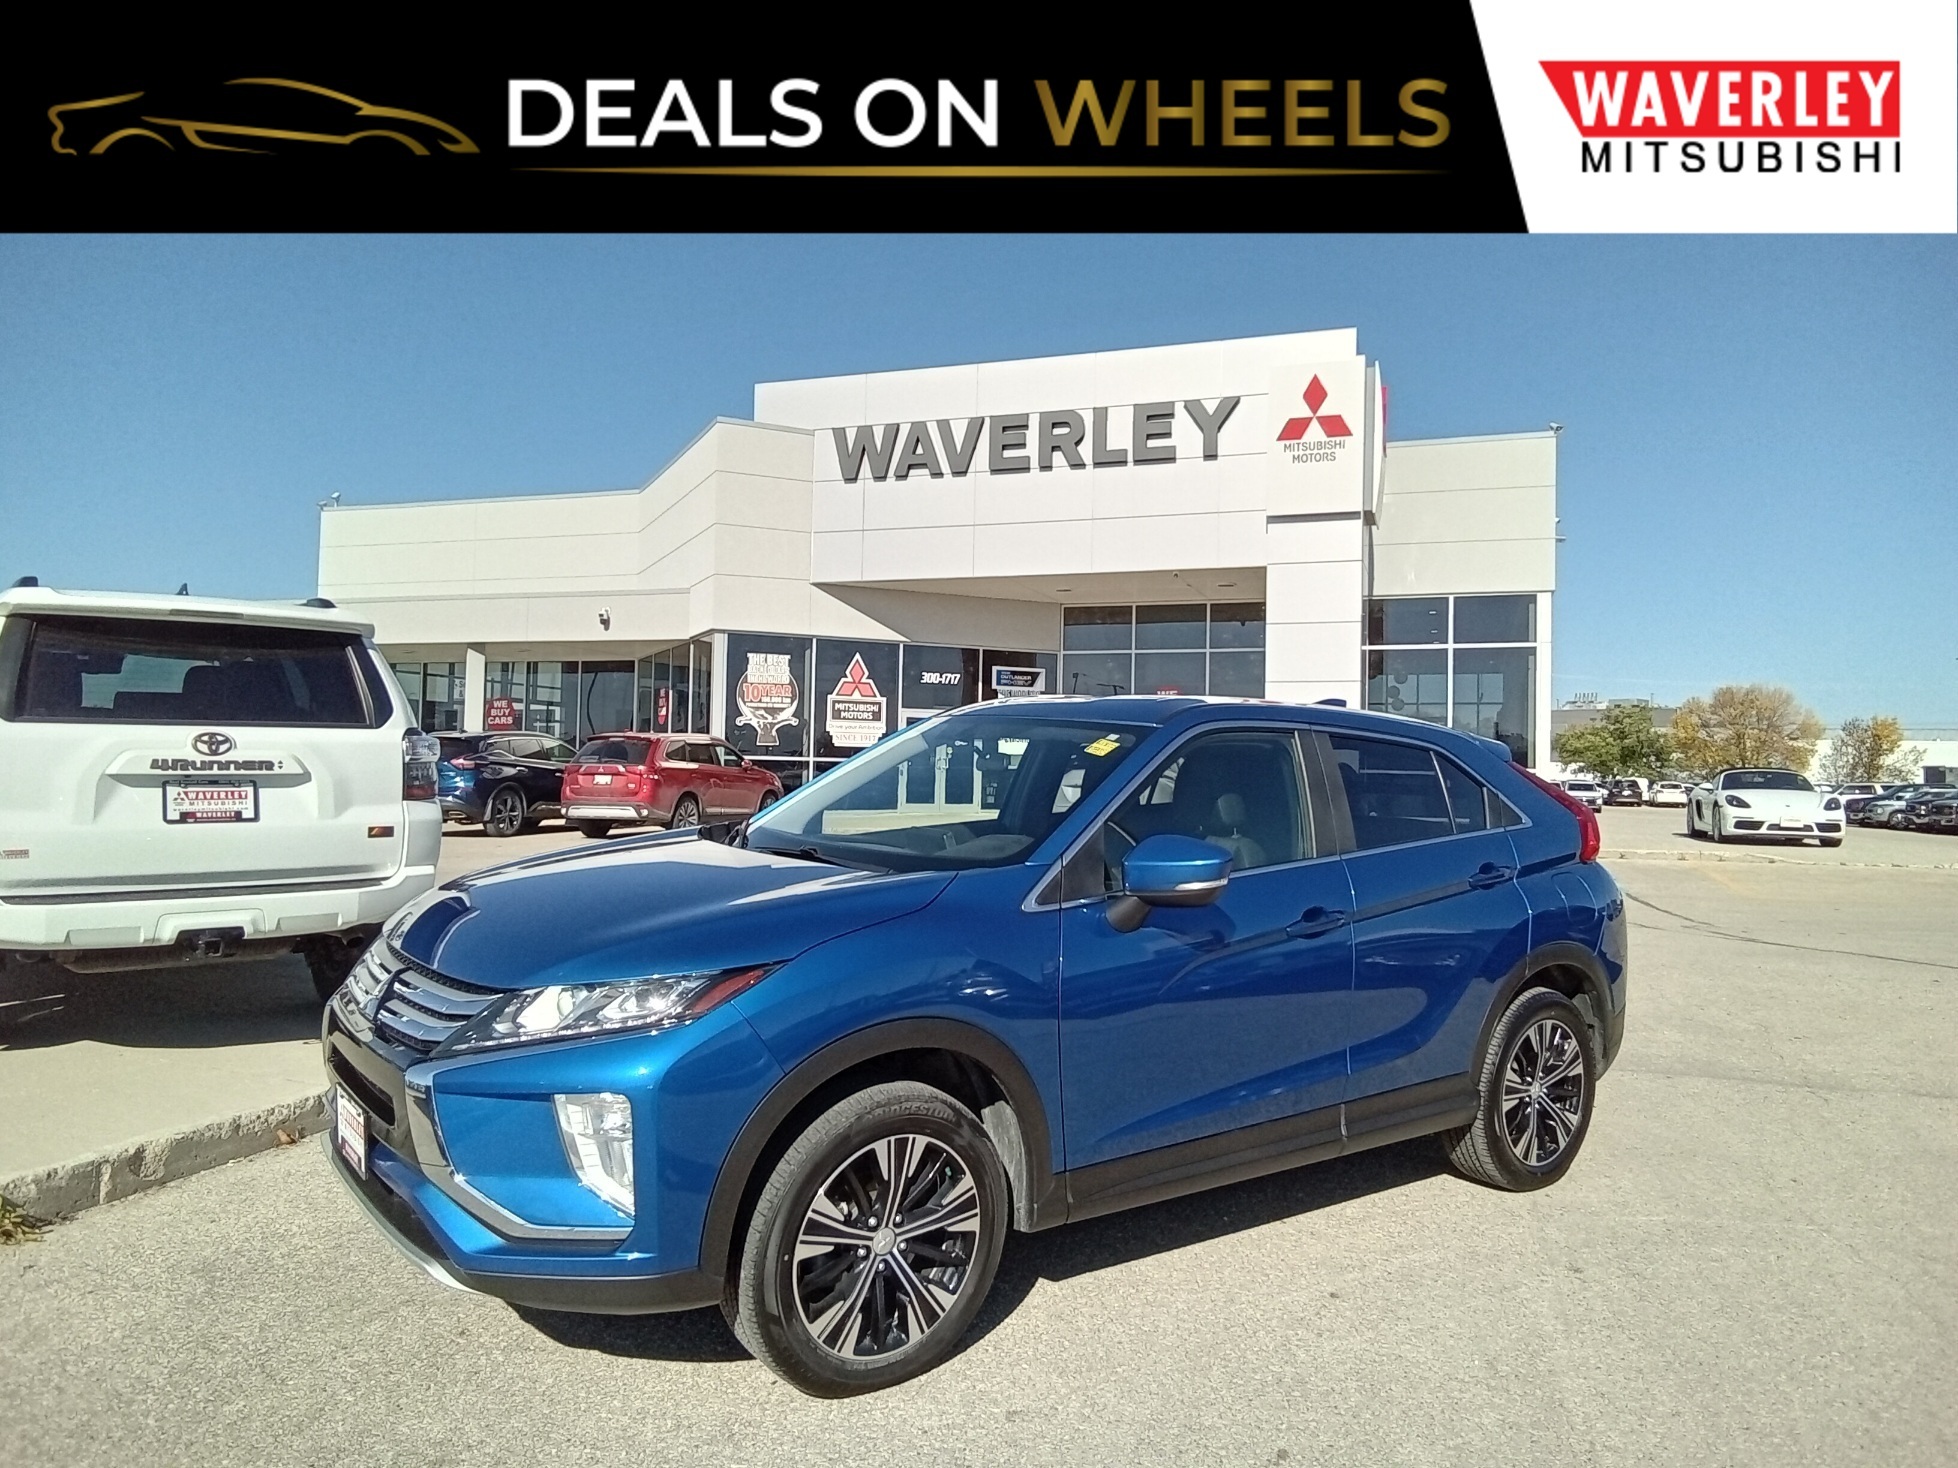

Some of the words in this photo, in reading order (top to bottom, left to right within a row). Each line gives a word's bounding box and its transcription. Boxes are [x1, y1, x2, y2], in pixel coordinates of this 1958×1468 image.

[832, 396, 1241, 484] WAVERLEY
[1284, 440, 1346, 453] MITSUBISHI
[1292, 452, 1337, 464] MOTORS
[747, 653, 766, 665] THE
[767, 654, 791, 667] BEST
[920, 671, 961, 685] 300-1717
[743, 683, 761, 702] 10
[761, 684, 792, 697] YEAR
[493, 700, 508, 708] WE
[834, 703, 879, 713] MITSUBISHI
[490, 708, 511, 716] BUY
[840, 711, 874, 720] MOTORS
[487, 716, 513, 725] CARS
[835, 733, 857, 742] SINCE
[187, 790, 248, 800] WAVERLEY
